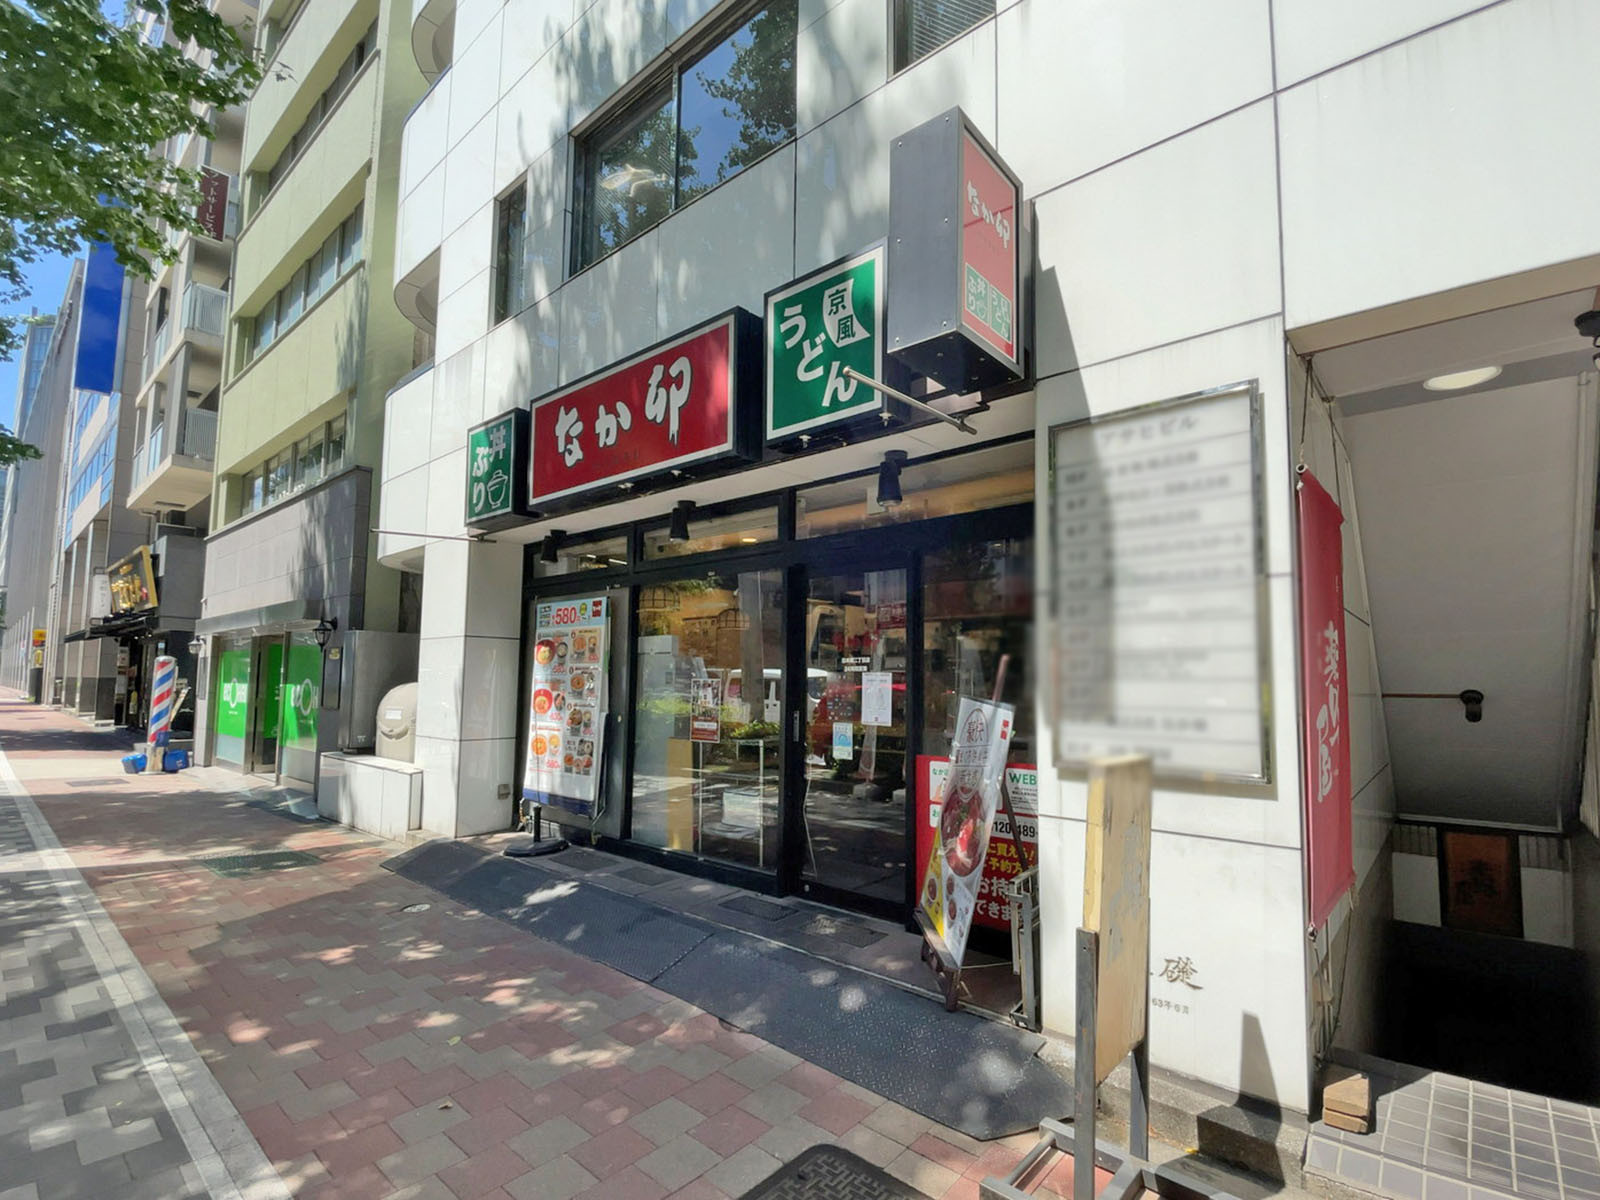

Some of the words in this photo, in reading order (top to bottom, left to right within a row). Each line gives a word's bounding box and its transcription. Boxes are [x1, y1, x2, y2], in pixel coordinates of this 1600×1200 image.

[967, 180, 1011, 249] なか卯
[828, 287, 856, 344] 京風
[779, 303, 858, 408] うどん
[555, 356, 692, 468] なか卯
[472, 446, 489, 513] ぶり
[555, 606, 577, 625] 580
[1009, 772, 1037, 786] WEB
[1156, 956, 1204, 990] 礎
